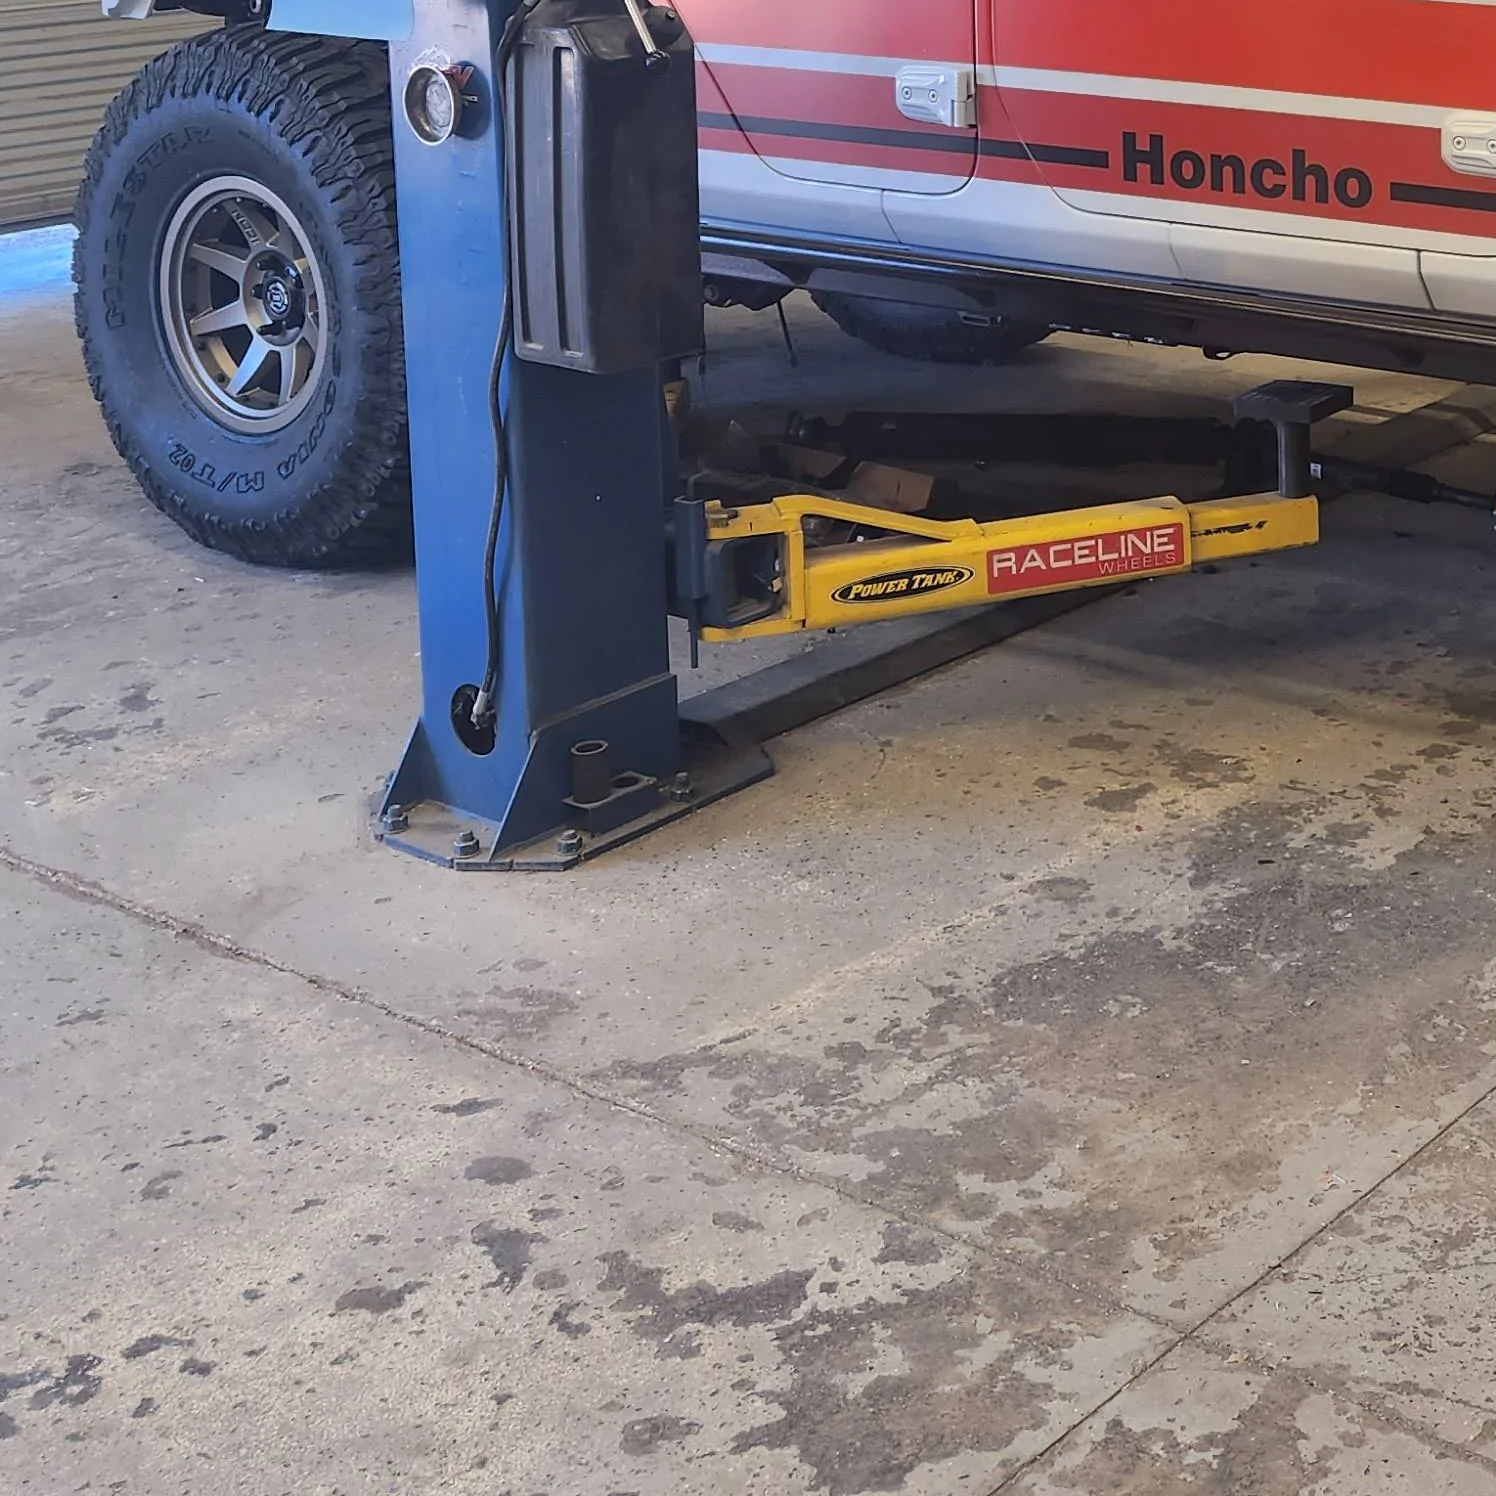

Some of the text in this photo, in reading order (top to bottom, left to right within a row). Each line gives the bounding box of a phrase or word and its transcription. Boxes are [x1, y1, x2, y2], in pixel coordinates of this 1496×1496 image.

[1121, 131, 1373, 209] Honcho
[992, 527, 1178, 579] RACELINE
[1098, 551, 1177, 576] WHEELS
[848, 570, 961, 600] POWER TANK
